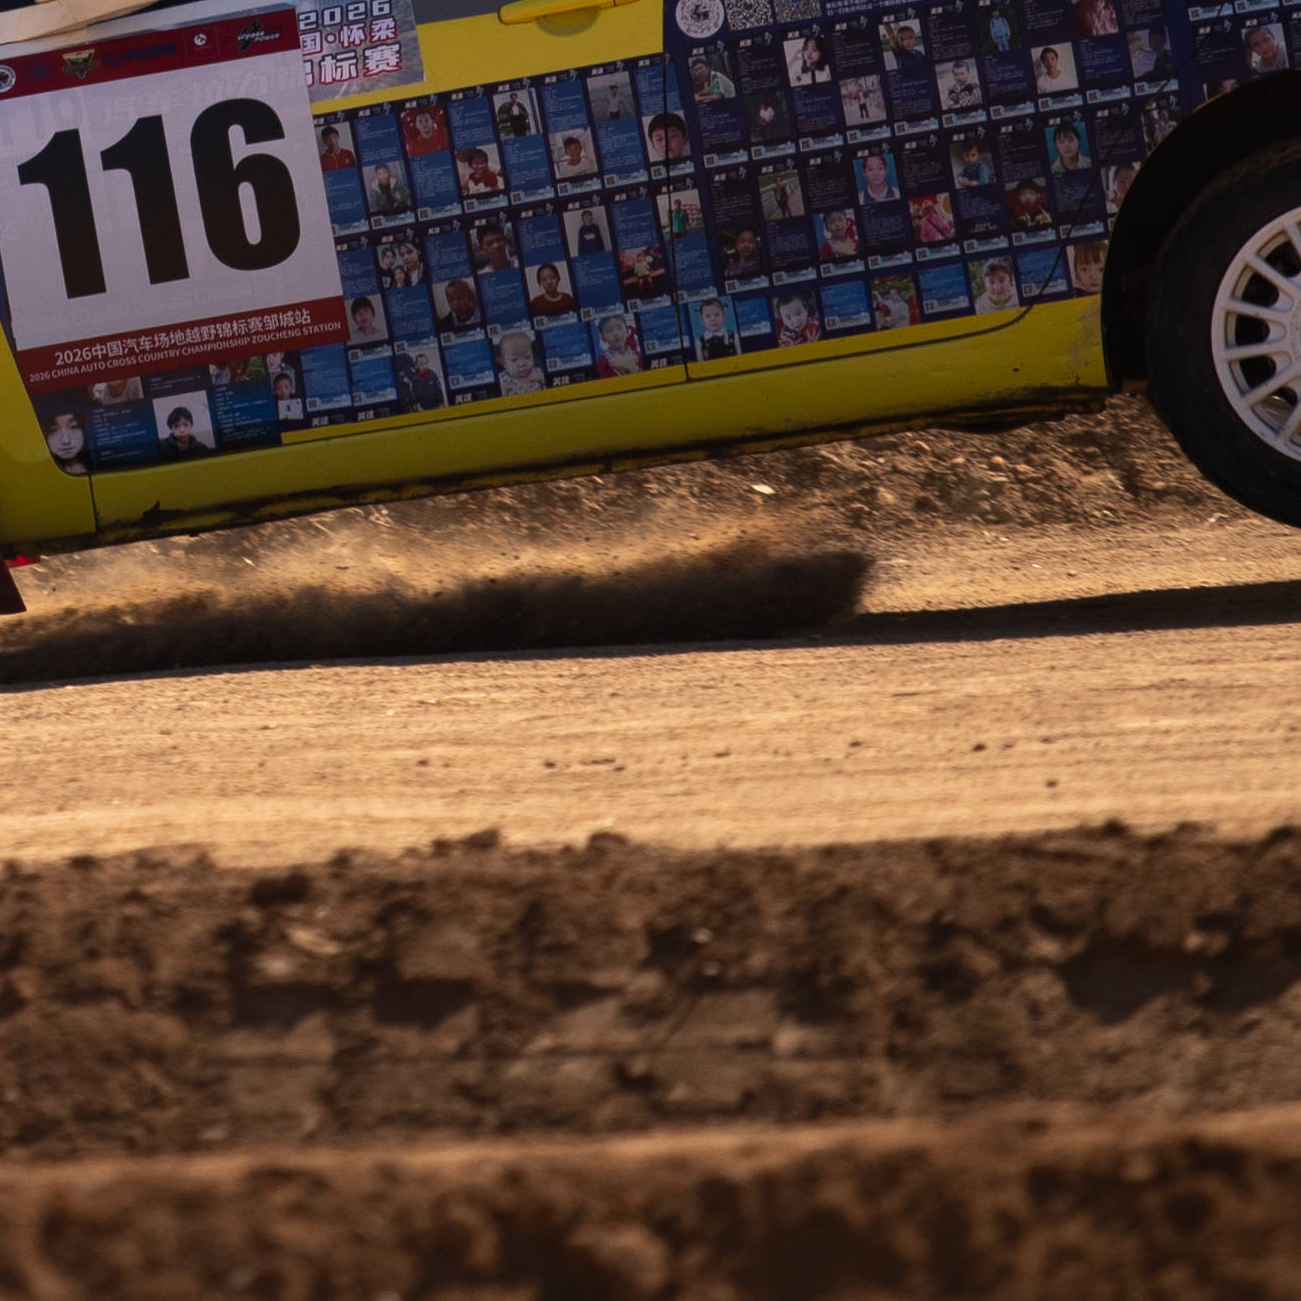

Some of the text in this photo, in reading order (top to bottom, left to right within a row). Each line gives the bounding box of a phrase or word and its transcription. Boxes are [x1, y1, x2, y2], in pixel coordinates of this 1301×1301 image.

[17, 98, 301, 299] 116
[29, 321, 342, 383] 2026 CHINA AUTO CROSS COUNTRY CHAMPIONSHIP ZOUCHENG STATION
